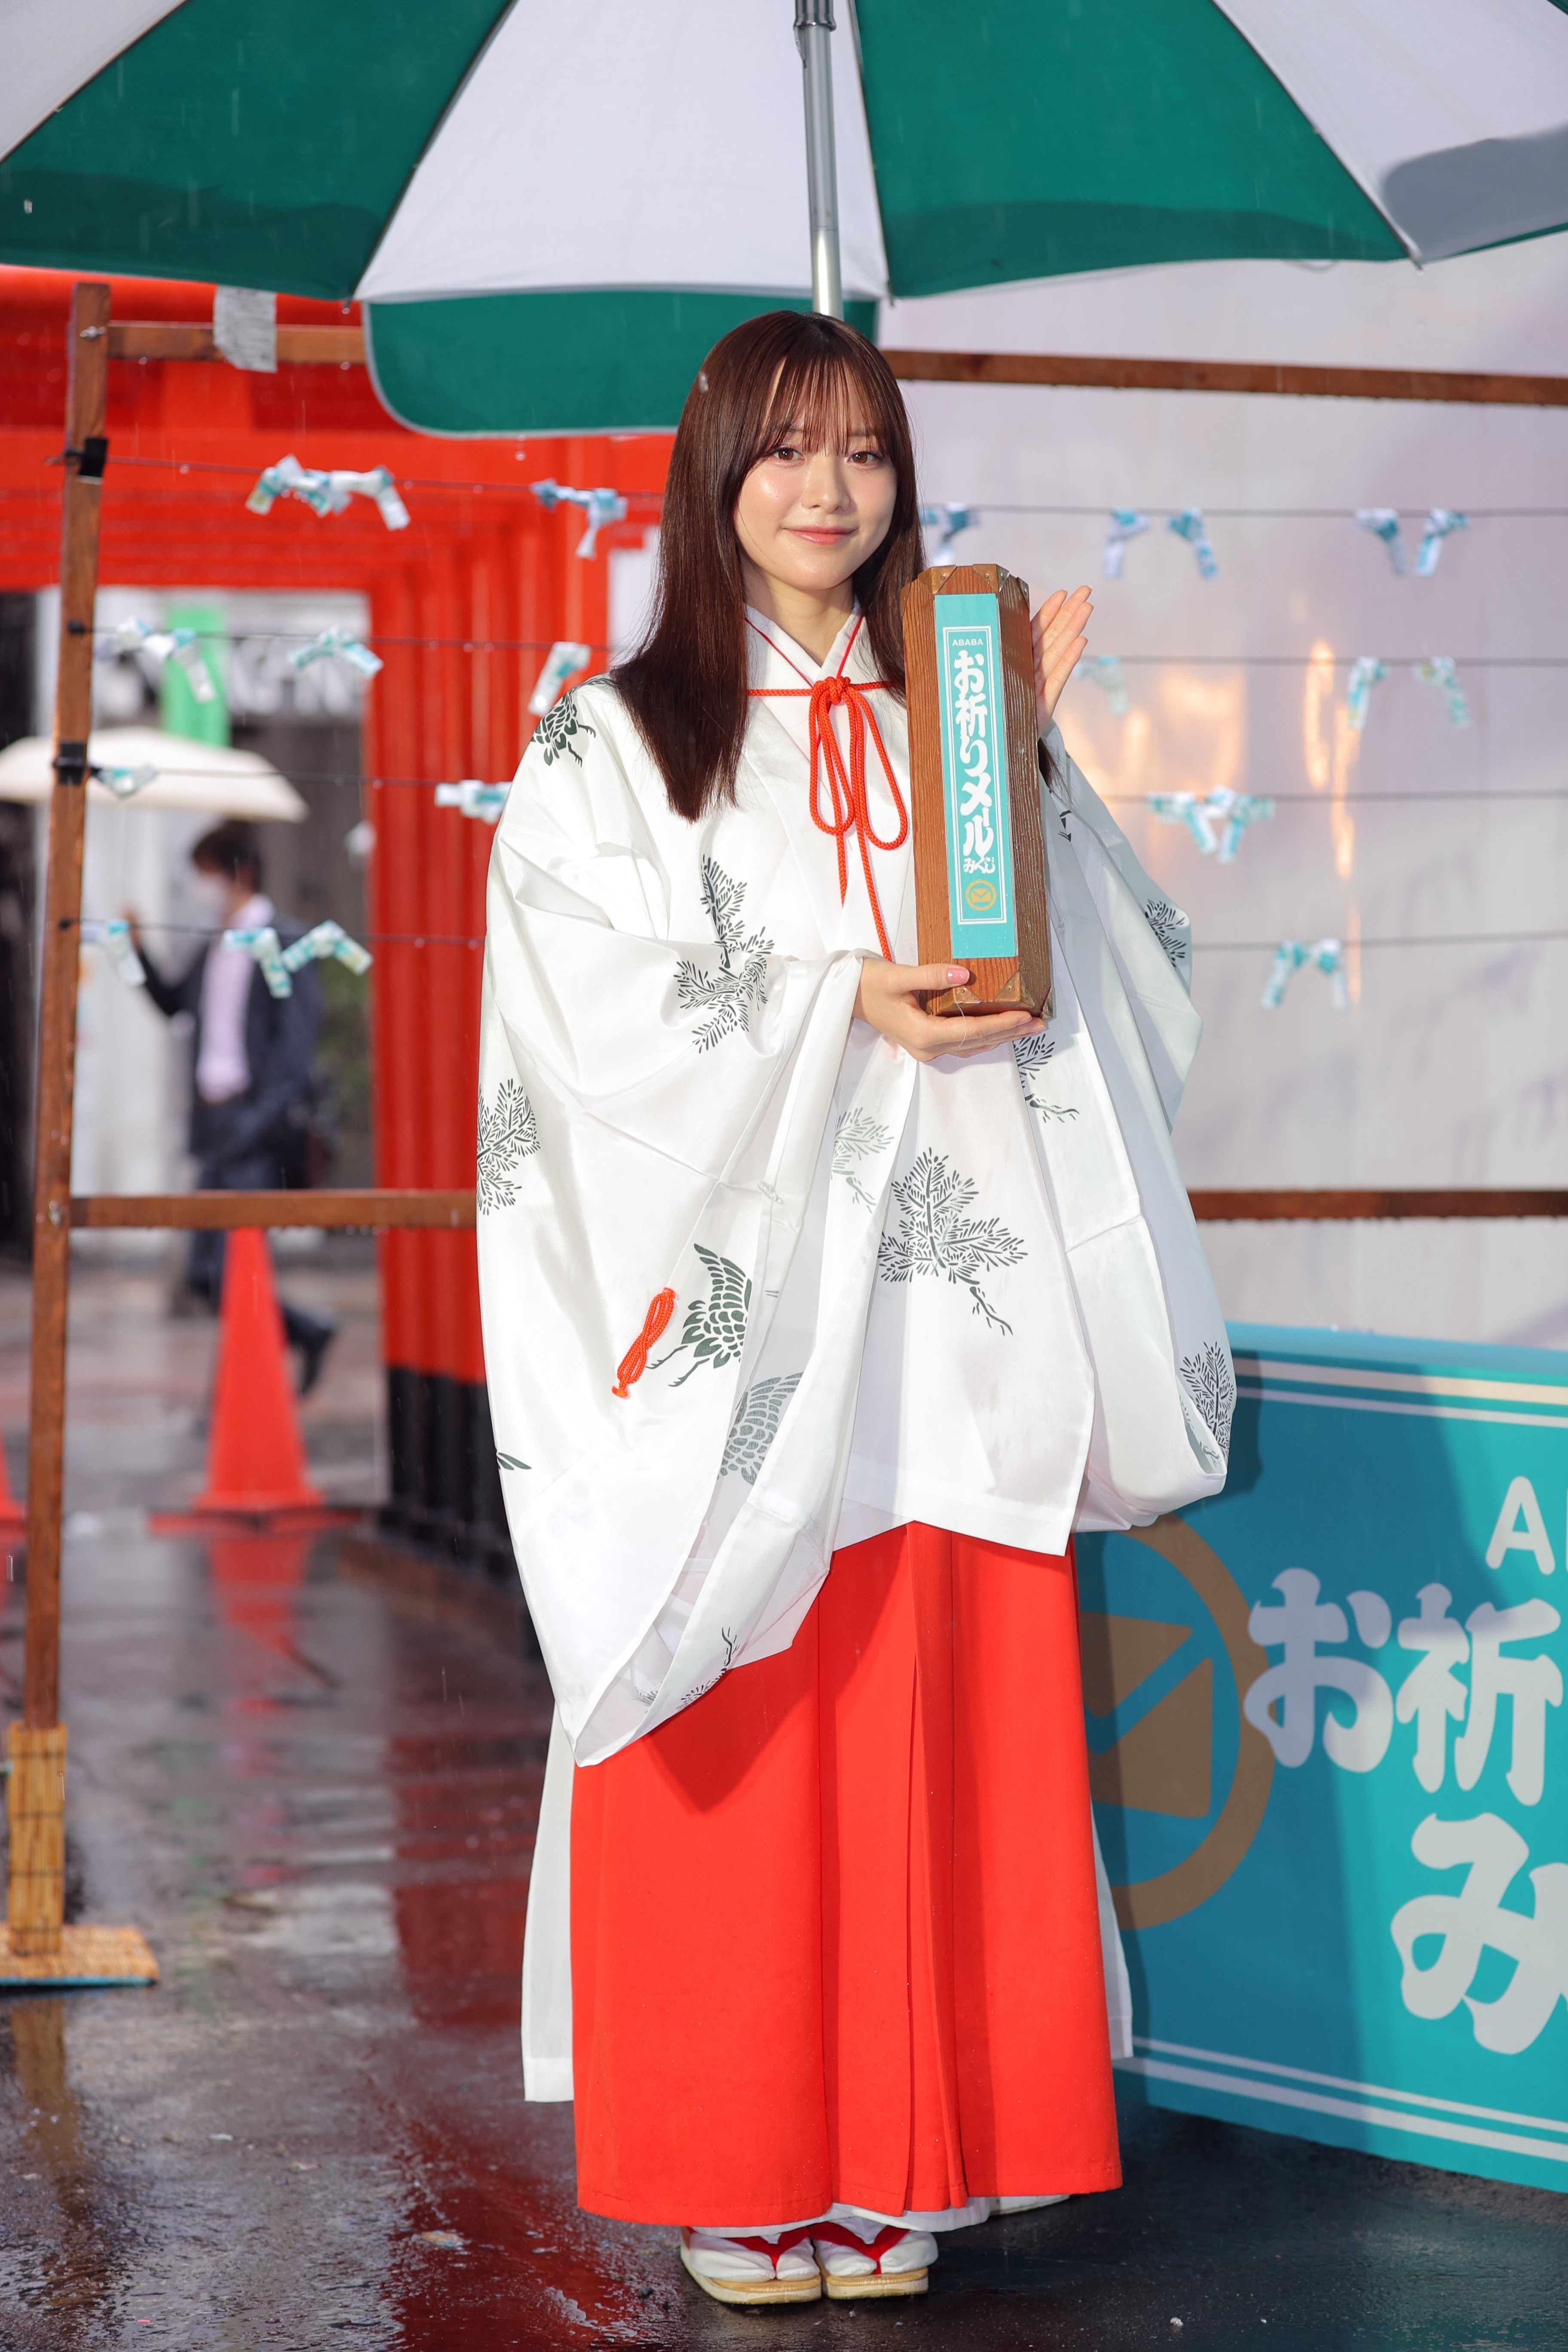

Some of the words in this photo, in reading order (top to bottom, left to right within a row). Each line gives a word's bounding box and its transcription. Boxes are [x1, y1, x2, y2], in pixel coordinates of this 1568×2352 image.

[952, 638, 983, 646] ABABA
[953, 649, 994, 859] お祈りメール
[963, 856, 995, 874] みくじ
[1485, 1476, 1568, 1575] A
[1243, 1568, 1563, 1806] お祈
[1390, 1812, 1568, 2055] み
